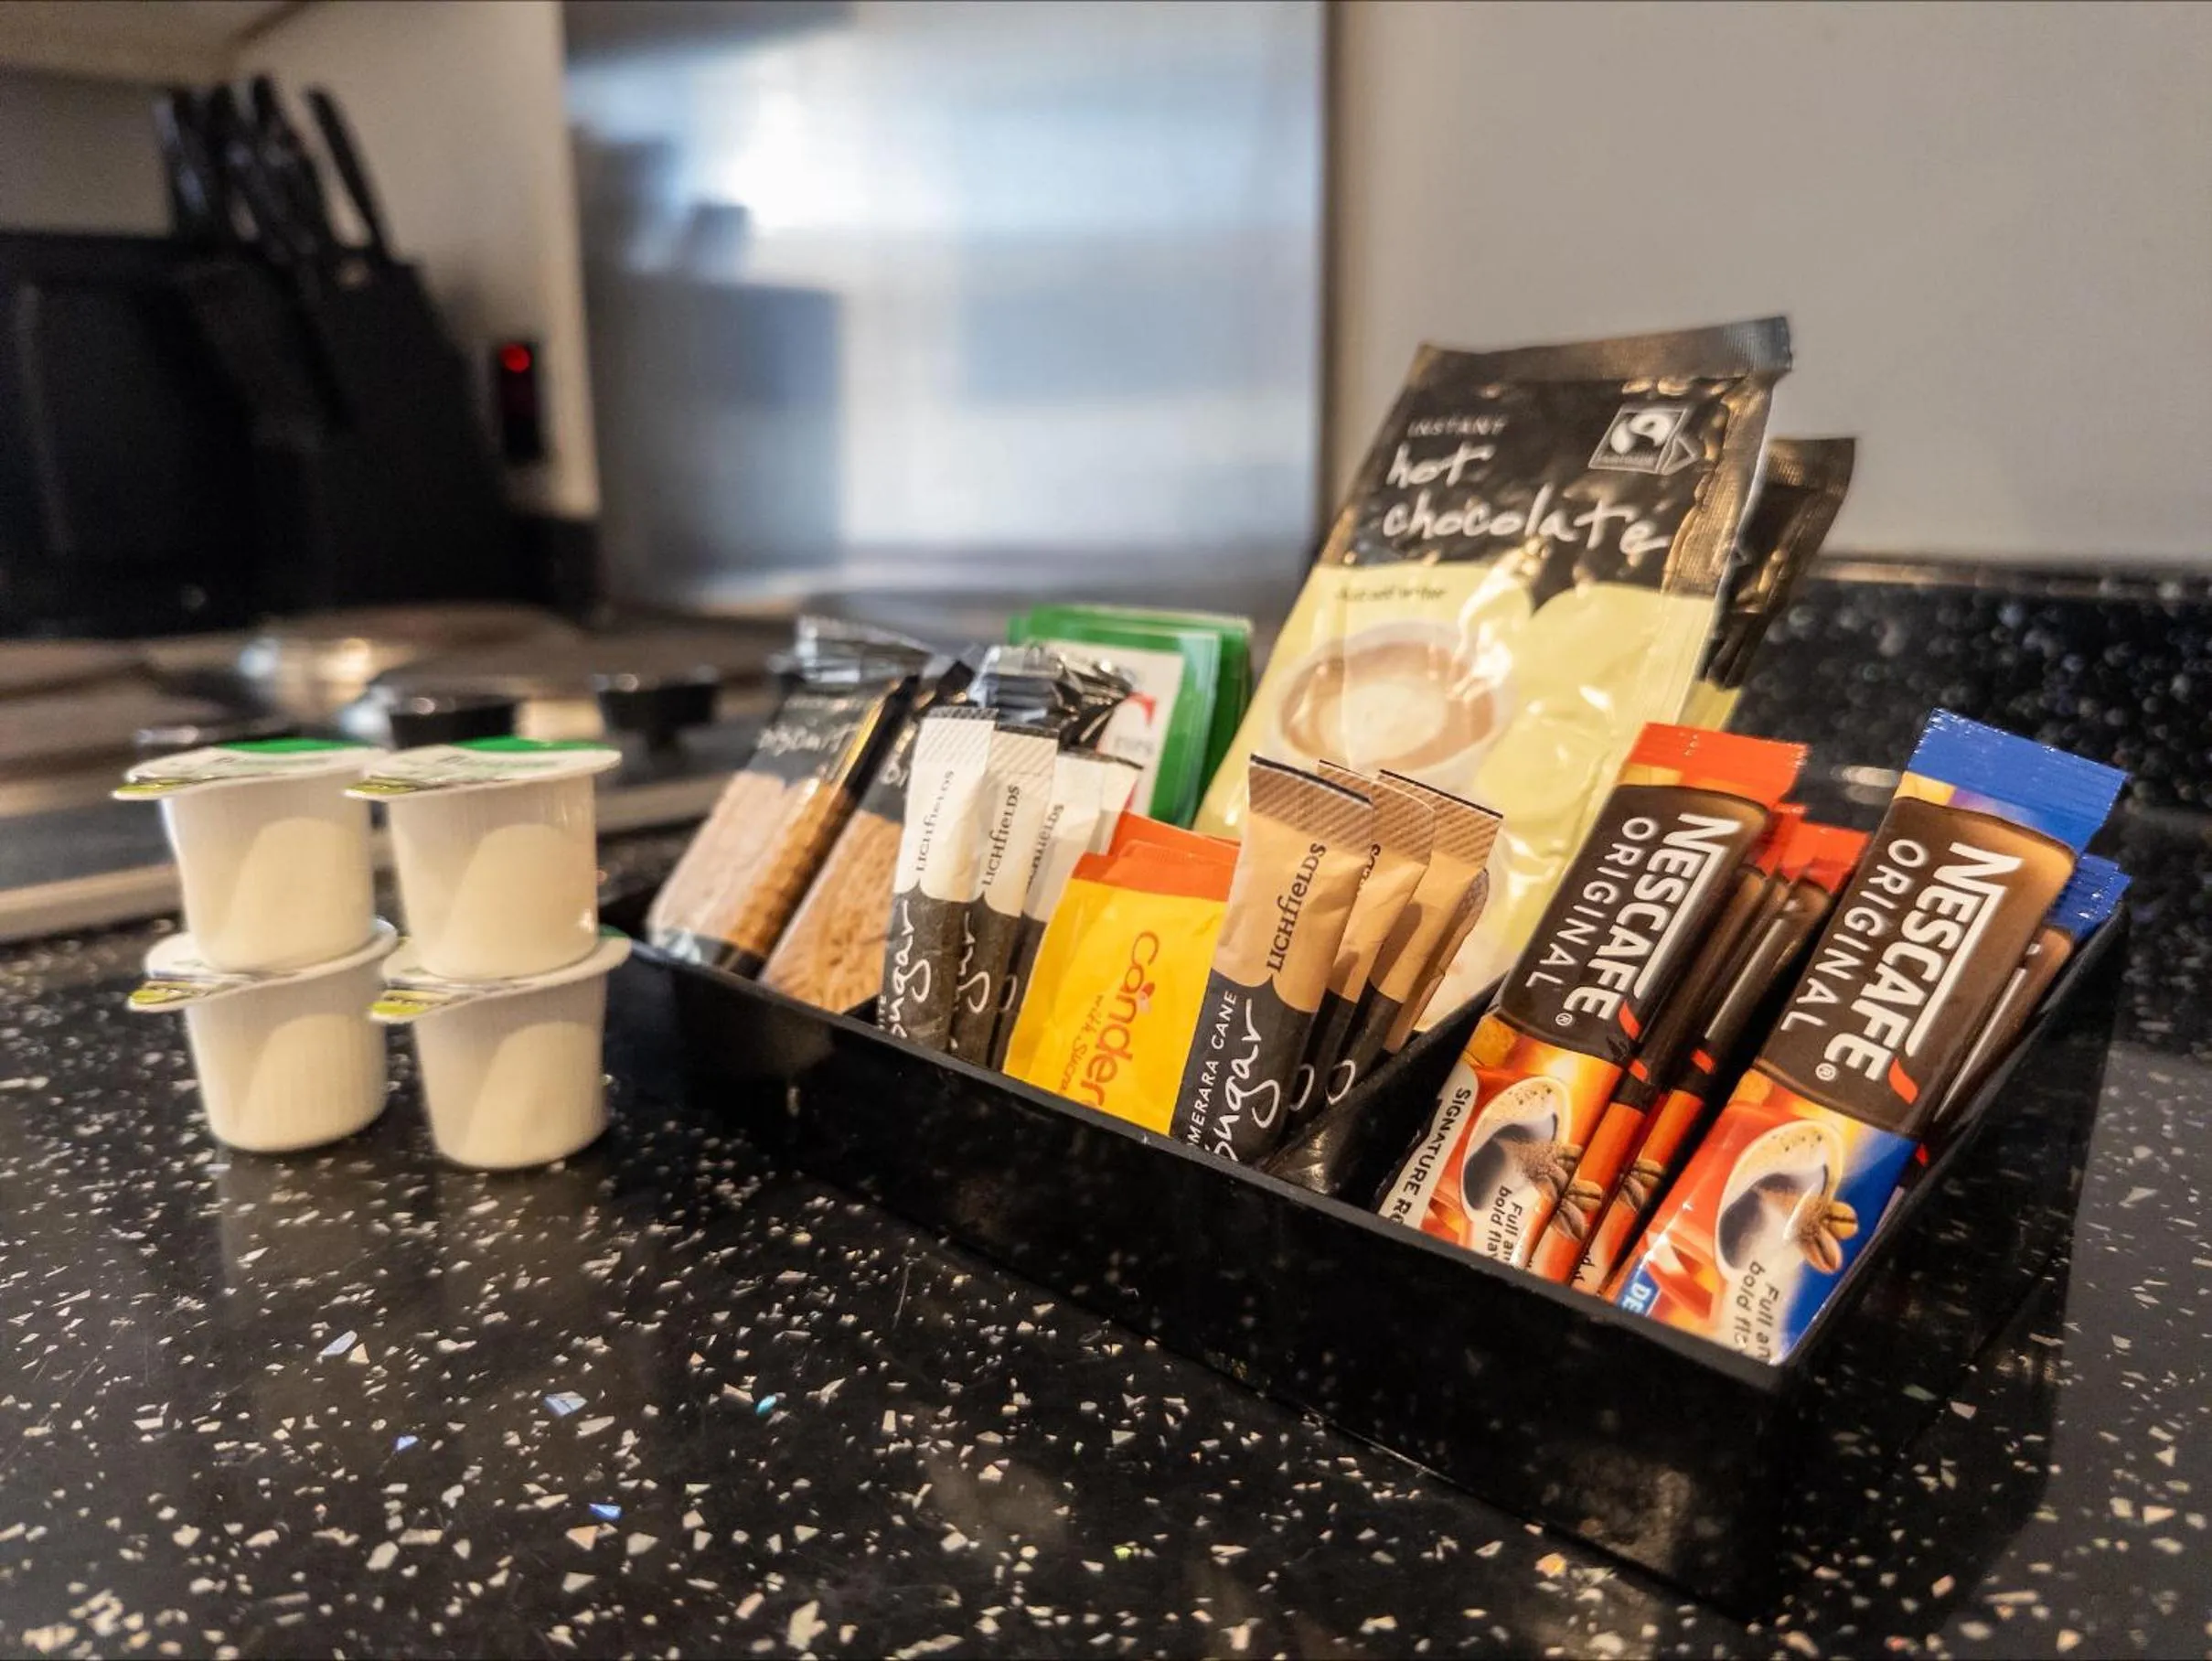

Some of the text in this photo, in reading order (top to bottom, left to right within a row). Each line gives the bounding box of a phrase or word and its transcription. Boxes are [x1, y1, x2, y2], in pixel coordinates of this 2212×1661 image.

[1407, 415, 1509, 437] INSTANT
[1386, 442, 1496, 488] hot
[1382, 483, 1672, 555] chocolate
[1525, 816, 1658, 989] ORIGINAL
[1781, 838, 1929, 1032] ORIGINAL
[1080, 930, 1160, 1108] Cander
[1187, 991, 1237, 1145] MERARA CANE
[1204, 998, 1280, 1163] sugar
[1403, 1087, 1471, 1195] SIGNATURE
[1491, 1185, 1512, 1226] bold
[1505, 1201, 1523, 1238] Full
[1622, 1282, 1652, 1313] DE
[1736, 1260, 1766, 1313] bold
[1755, 1283, 1779, 1360] Full an
